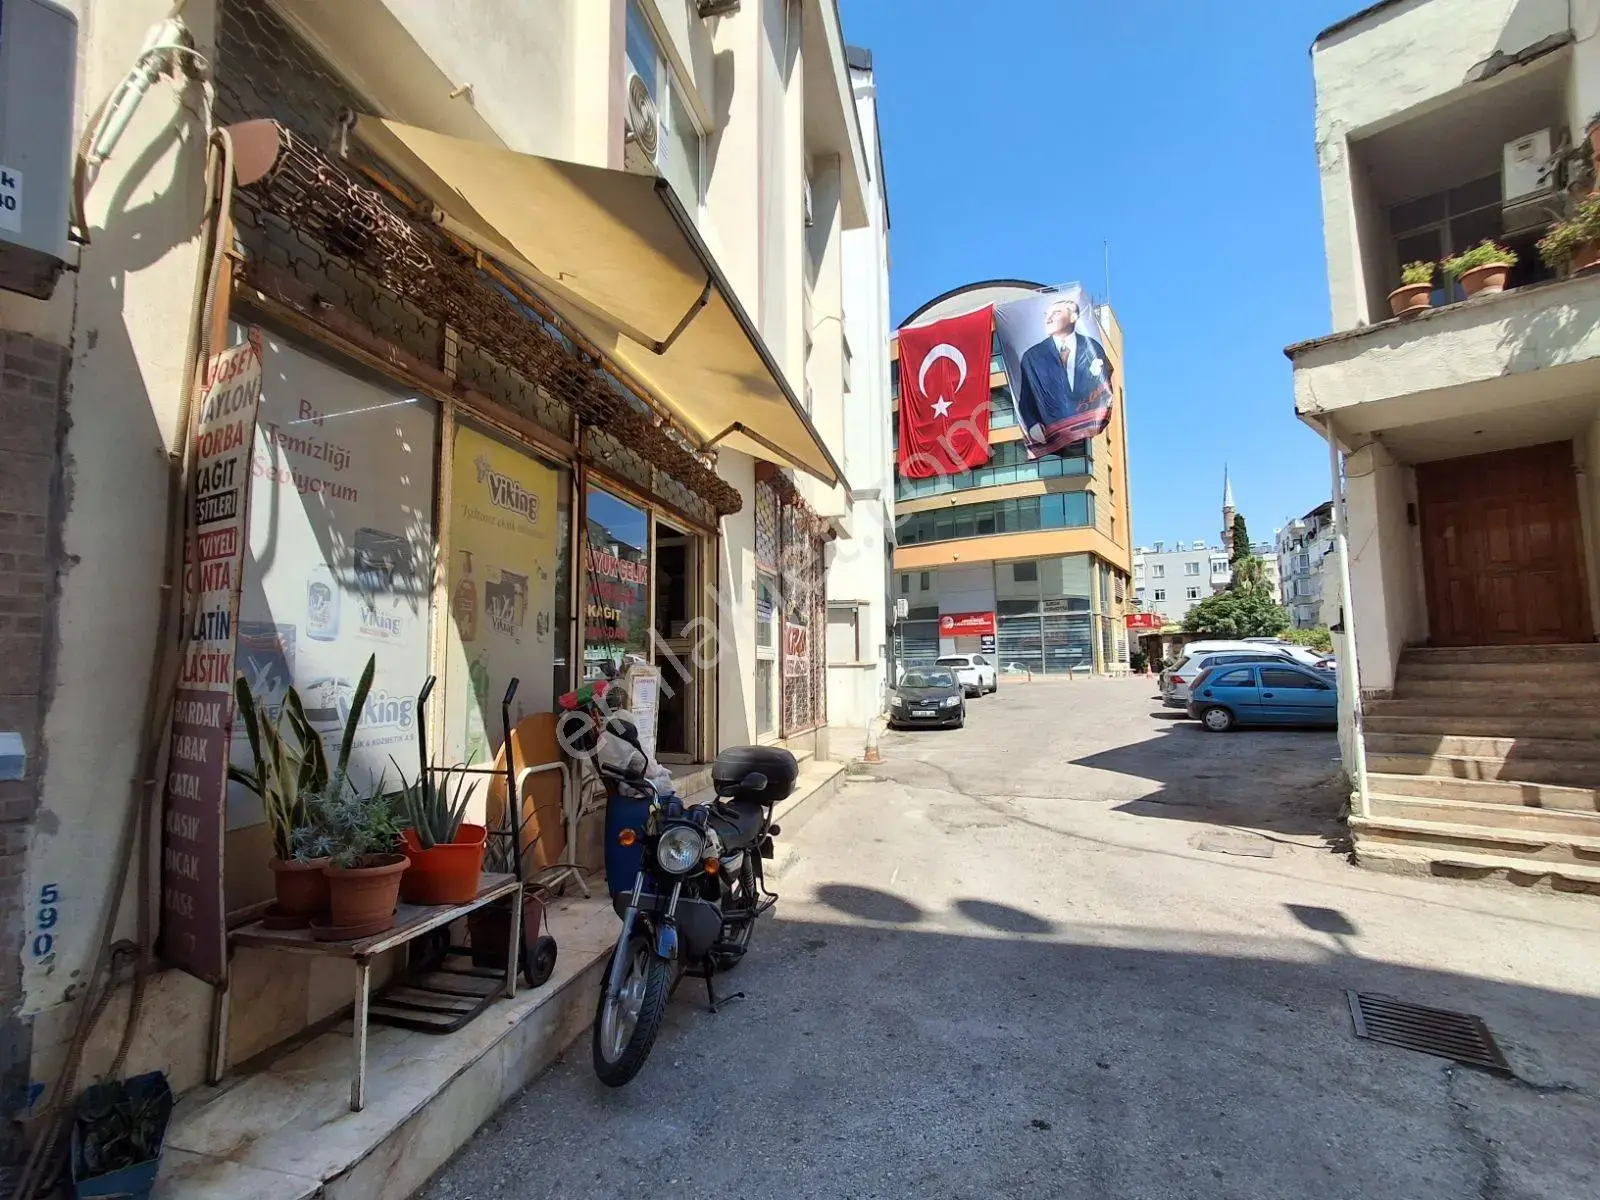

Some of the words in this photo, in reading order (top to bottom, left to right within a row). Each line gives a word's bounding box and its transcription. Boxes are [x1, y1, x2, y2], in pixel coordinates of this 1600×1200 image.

[298, 398, 324, 427] Bu
[266, 421, 351, 472] Temizliği
[251, 455, 358, 503] Seviyorum
[488, 473, 538, 524] Viking
[185, 562, 231, 601] ÇNTA
[174, 700, 221, 729] BARDAK
[336, 690, 415, 730] Vking
